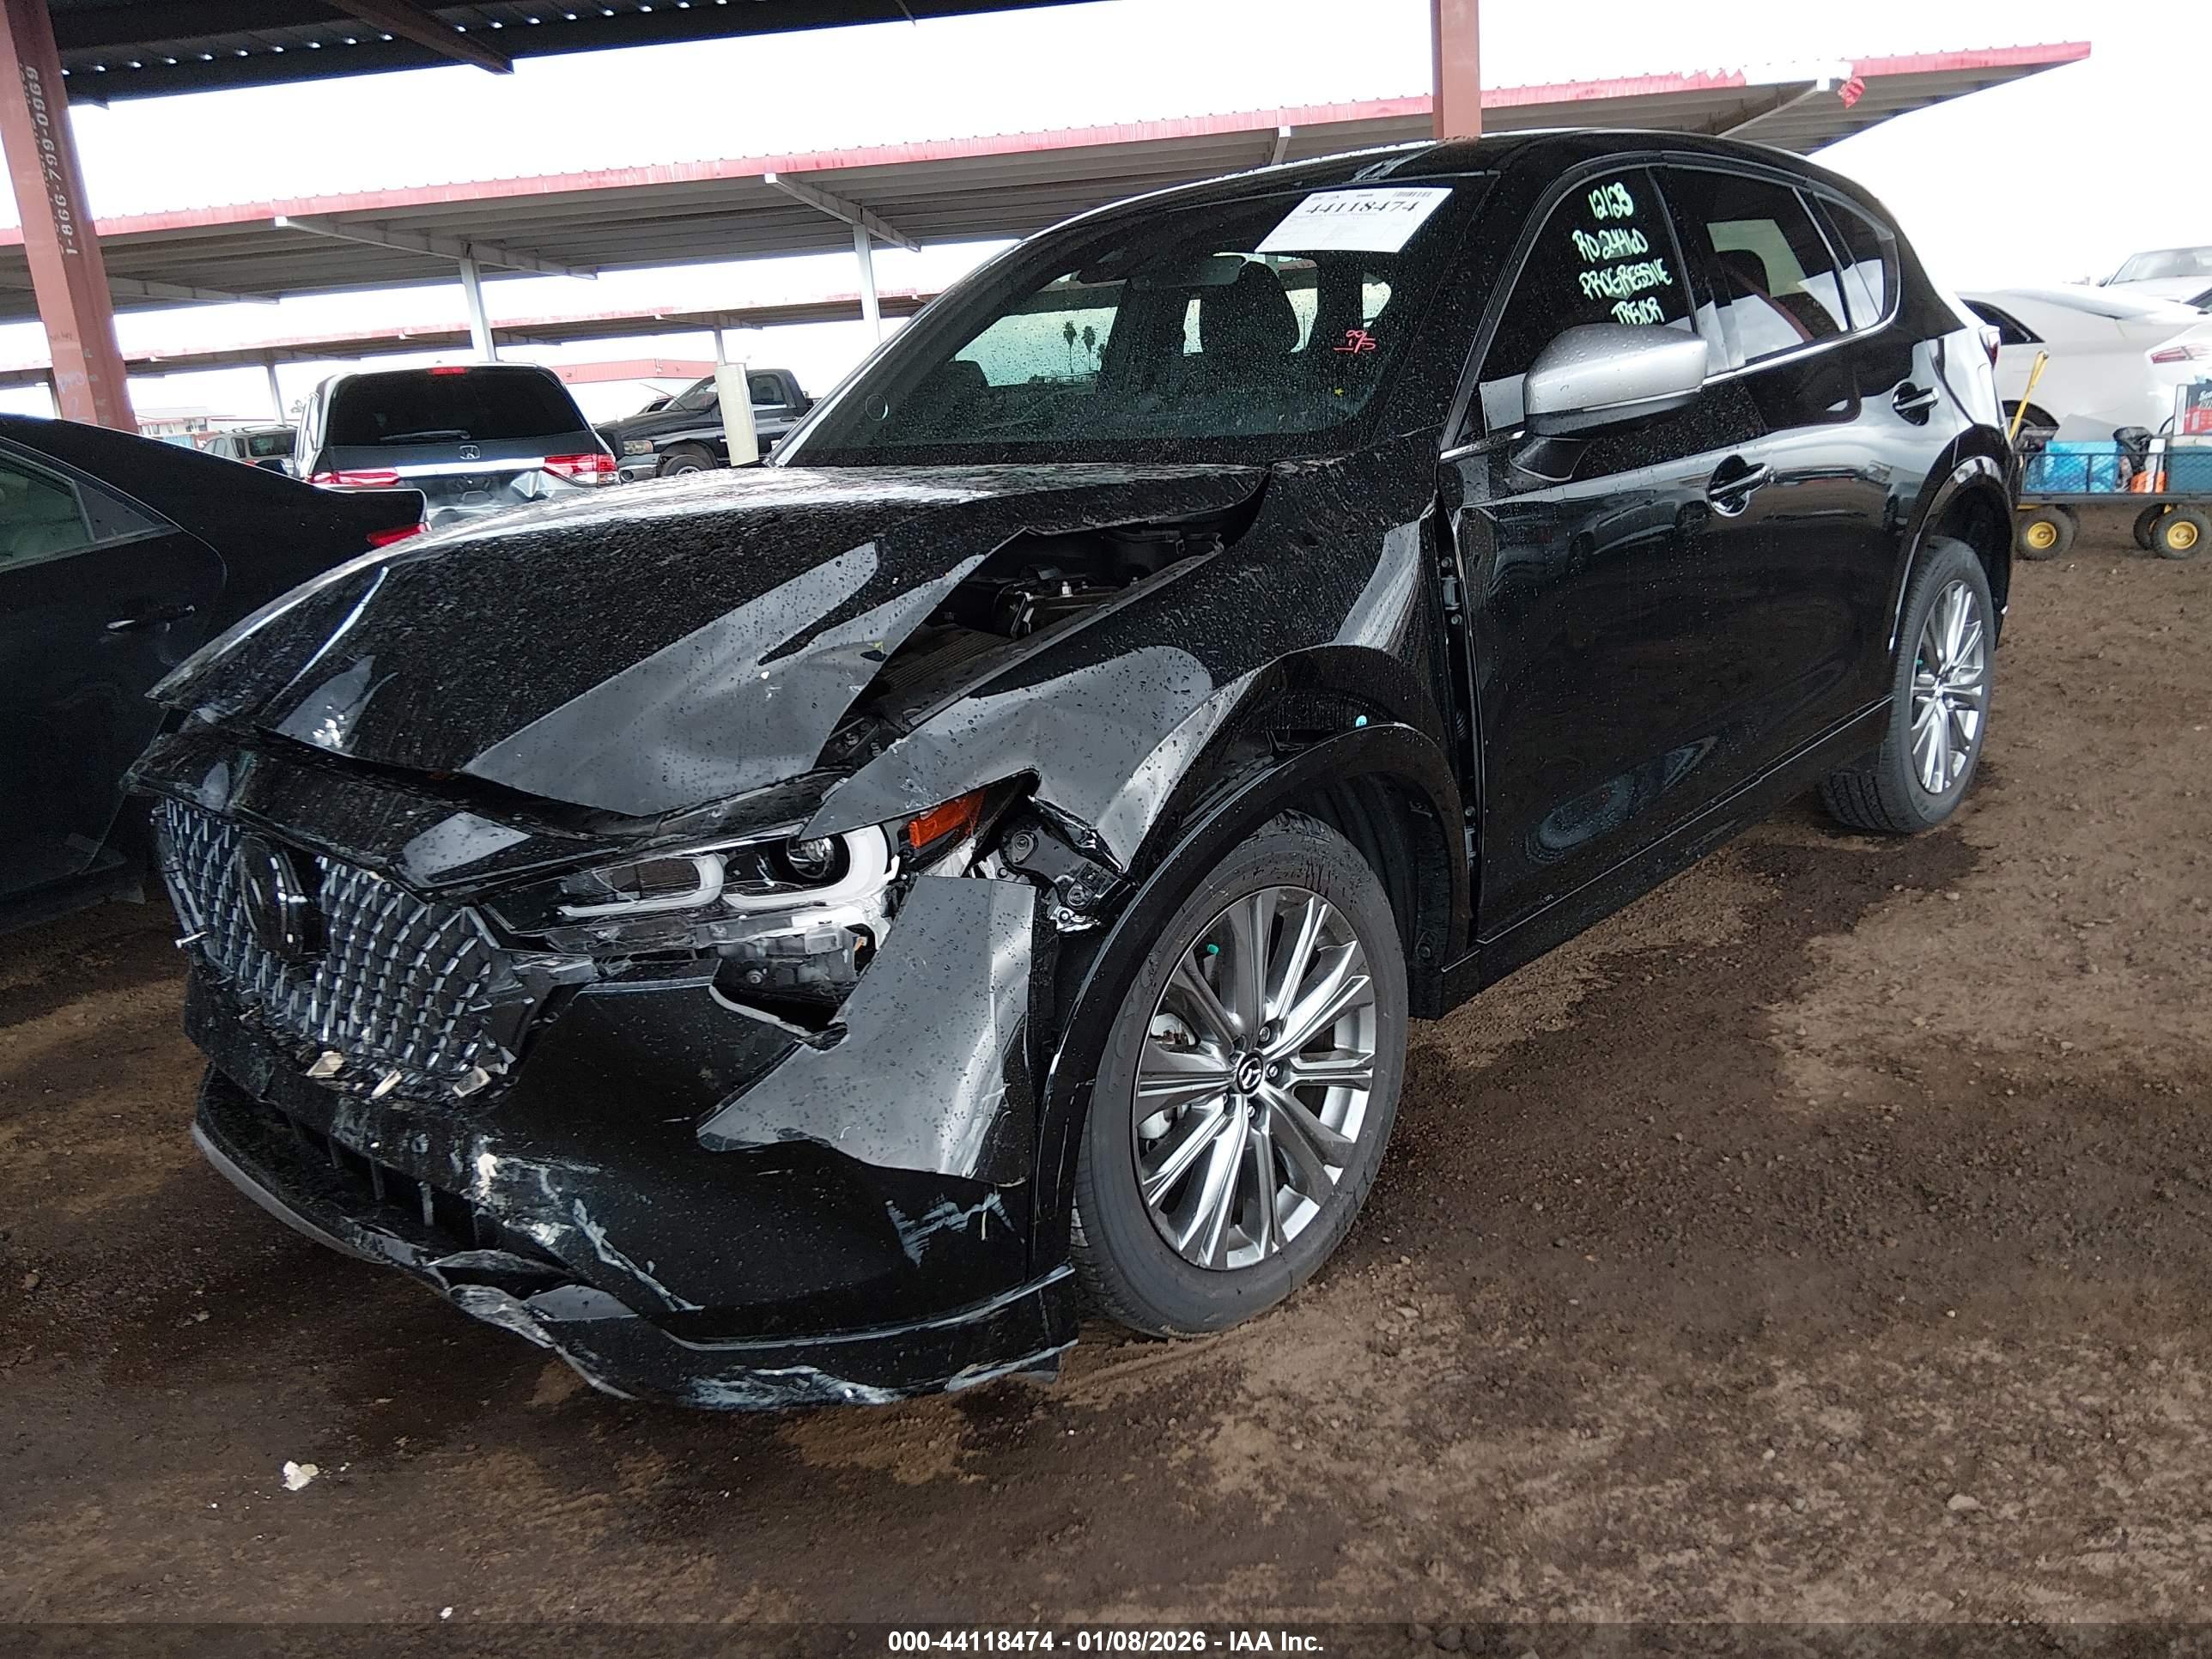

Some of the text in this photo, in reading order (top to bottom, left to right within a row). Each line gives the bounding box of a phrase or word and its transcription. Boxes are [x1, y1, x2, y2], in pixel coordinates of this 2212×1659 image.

[1305, 200, 1420, 215] 44118474
[1578, 258, 1673, 300] PROGRESSIVE
[1611, 296, 1665, 325] TREVOR
